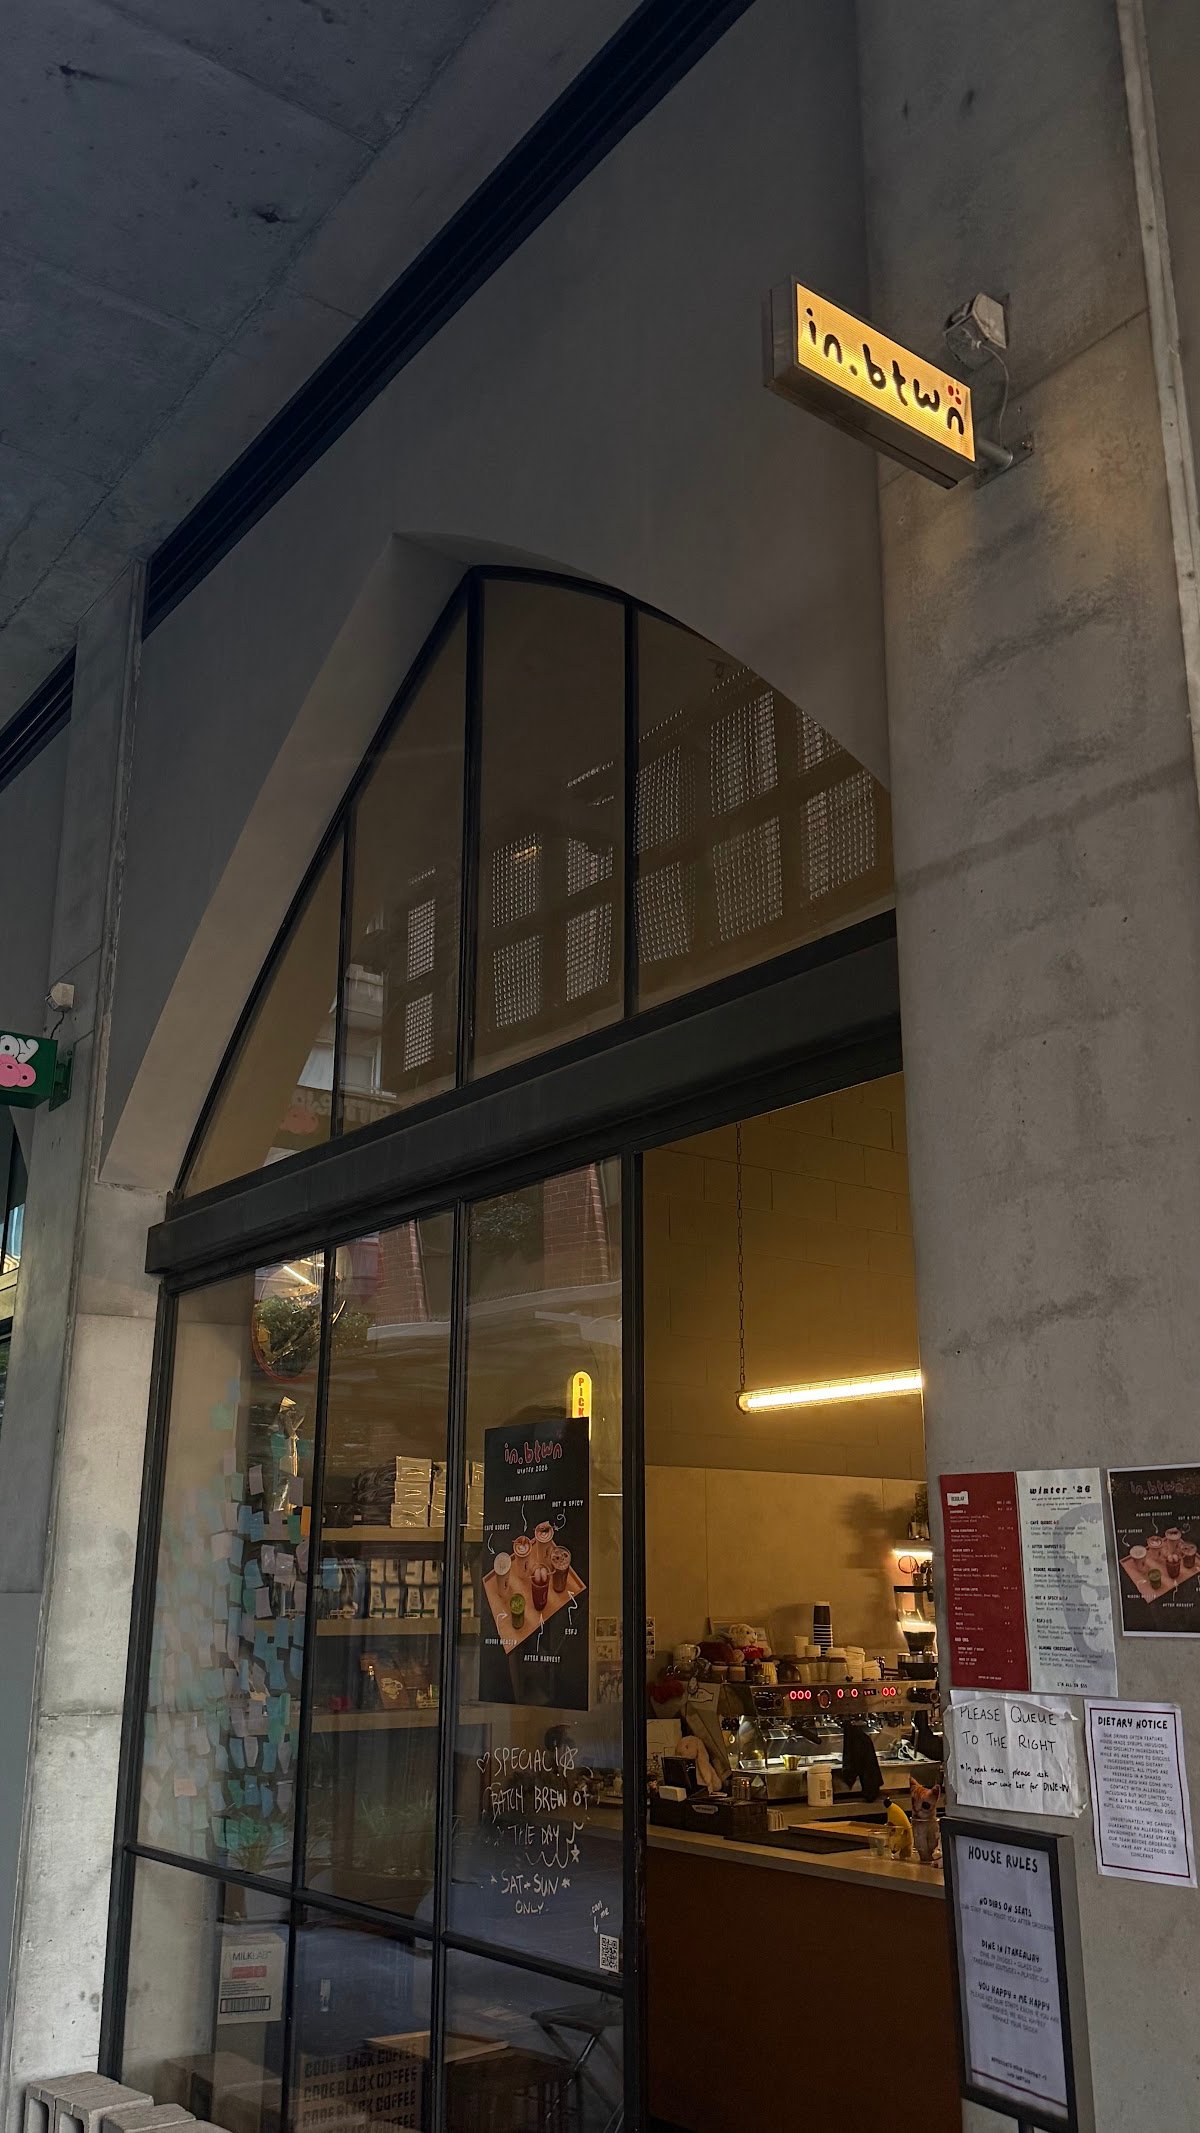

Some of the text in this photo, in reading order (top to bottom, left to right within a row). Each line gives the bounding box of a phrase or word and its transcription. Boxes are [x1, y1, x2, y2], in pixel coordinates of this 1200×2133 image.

[806, 307, 965, 436] in.btwn
[1029, 1486, 1068, 1494] winter
[568, 1499, 584, 1507] SPICY
[960, 1705, 1057, 1726] PLEASE QUEUE
[1097, 1716, 1168, 1730] DIETARY NOTICE
[962, 1730, 1057, 1754] TO THE RIGHT
[1012, 1768, 1031, 1779] please
[490, 1785, 525, 1823] BATCH
[534, 1786, 567, 1813] BREW
[508, 1822, 560, 1850] THE DAY
[968, 1845, 1038, 1874] HOUSE RULES
[501, 1869, 559, 1897] SAT SUN
[979, 1896, 988, 1907] NO
[1003, 1902, 1013, 1913] ON
[1014, 1904, 1032, 1918] SEATS
[982, 1939, 996, 1952] DINE
[978, 1981, 990, 1994] YOU
[991, 1985, 1012, 2000] HAPPY
[1018, 1993, 1027, 2005] ME
[1028, 1996, 1050, 2012] HAPPY
[376, 2066, 418, 2089] COFFEE
[376, 2090, 417, 2112] COFFEE
